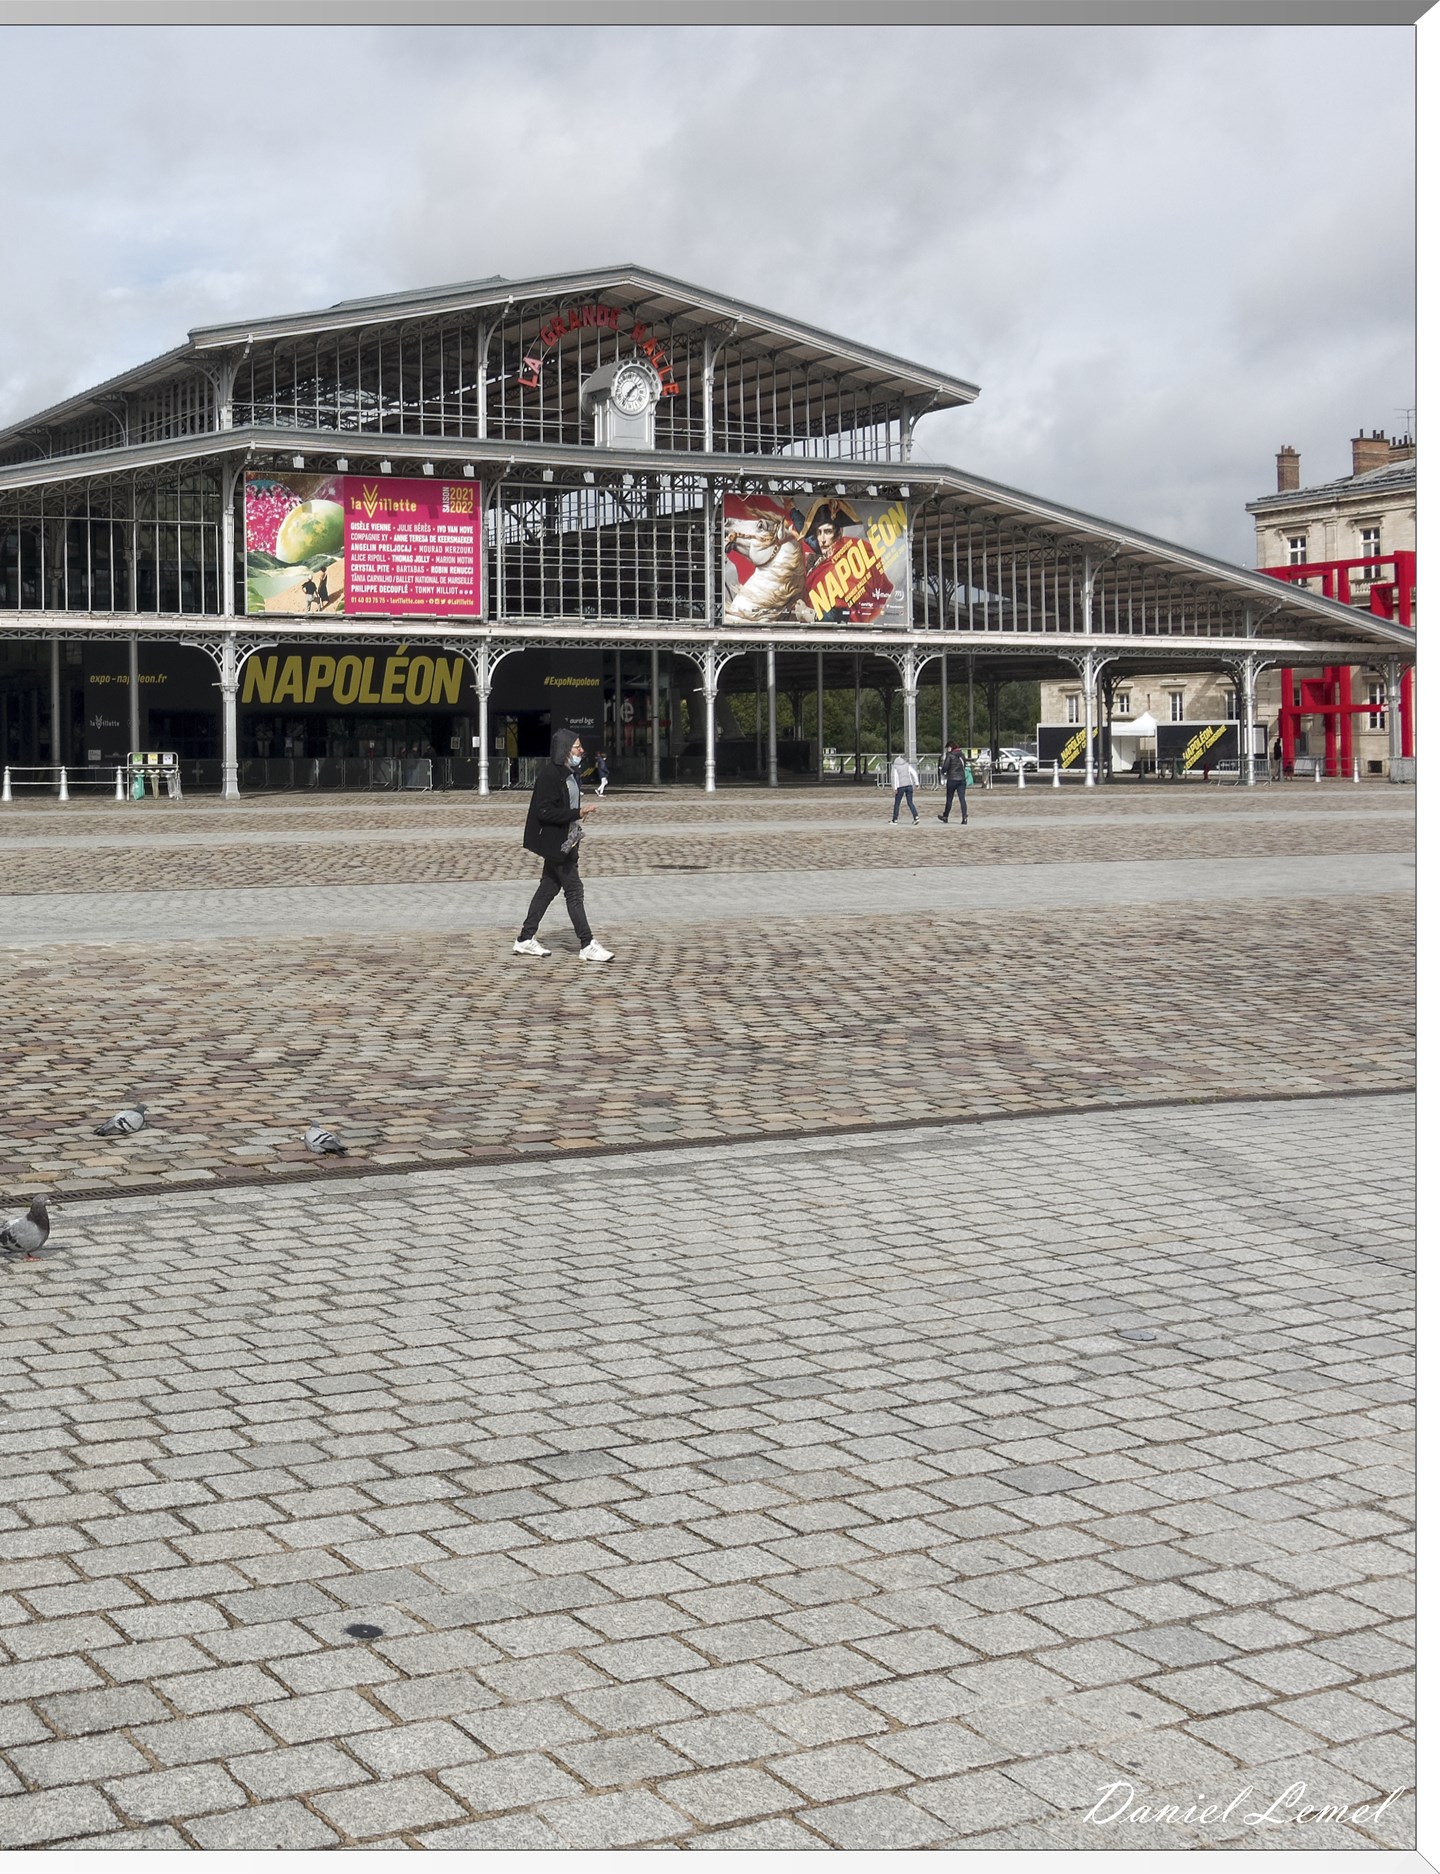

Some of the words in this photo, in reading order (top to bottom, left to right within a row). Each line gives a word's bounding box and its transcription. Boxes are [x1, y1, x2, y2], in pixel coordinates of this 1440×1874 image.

[517, 356, 543, 388] LA
[539, 304, 622, 347] GRANDE
[630, 319, 680, 398] HALLE
[450, 488, 474, 500] 2021
[450, 501, 474, 514] 2022
[350, 520, 370, 530] GISÈLE
[371, 523, 391, 532] VIENNE
[397, 524, 412, 532] JULIE
[448, 526, 458, 534] VAN
[350, 533, 380, 541] COMPAGNIE
[382, 534, 388, 542] XY
[394, 534, 408, 542] ANNE
[409, 534, 428, 542] TERESA
[350, 543, 376, 551] ANGELIN
[378, 544, 412, 552] PRELJOCAJ
[809, 501, 907, 620] NAPOLÉON
[350, 564, 376, 572] CRYSTAL
[377, 564, 390, 572] PITE
[396, 565, 424, 573] BARTABAS
[415, 576, 439, 584] NATIONAL
[448, 576, 474, 584] MARSEILLE
[351, 584, 378, 592] PHILIPPE
[379, 584, 408, 594] DECOUFLÉ
[242, 644, 464, 705] NAPOLÉON
[544, 676, 600, 687] #ExpoNapoleon
[1183, 726, 1214, 760] NAPOLÉON
